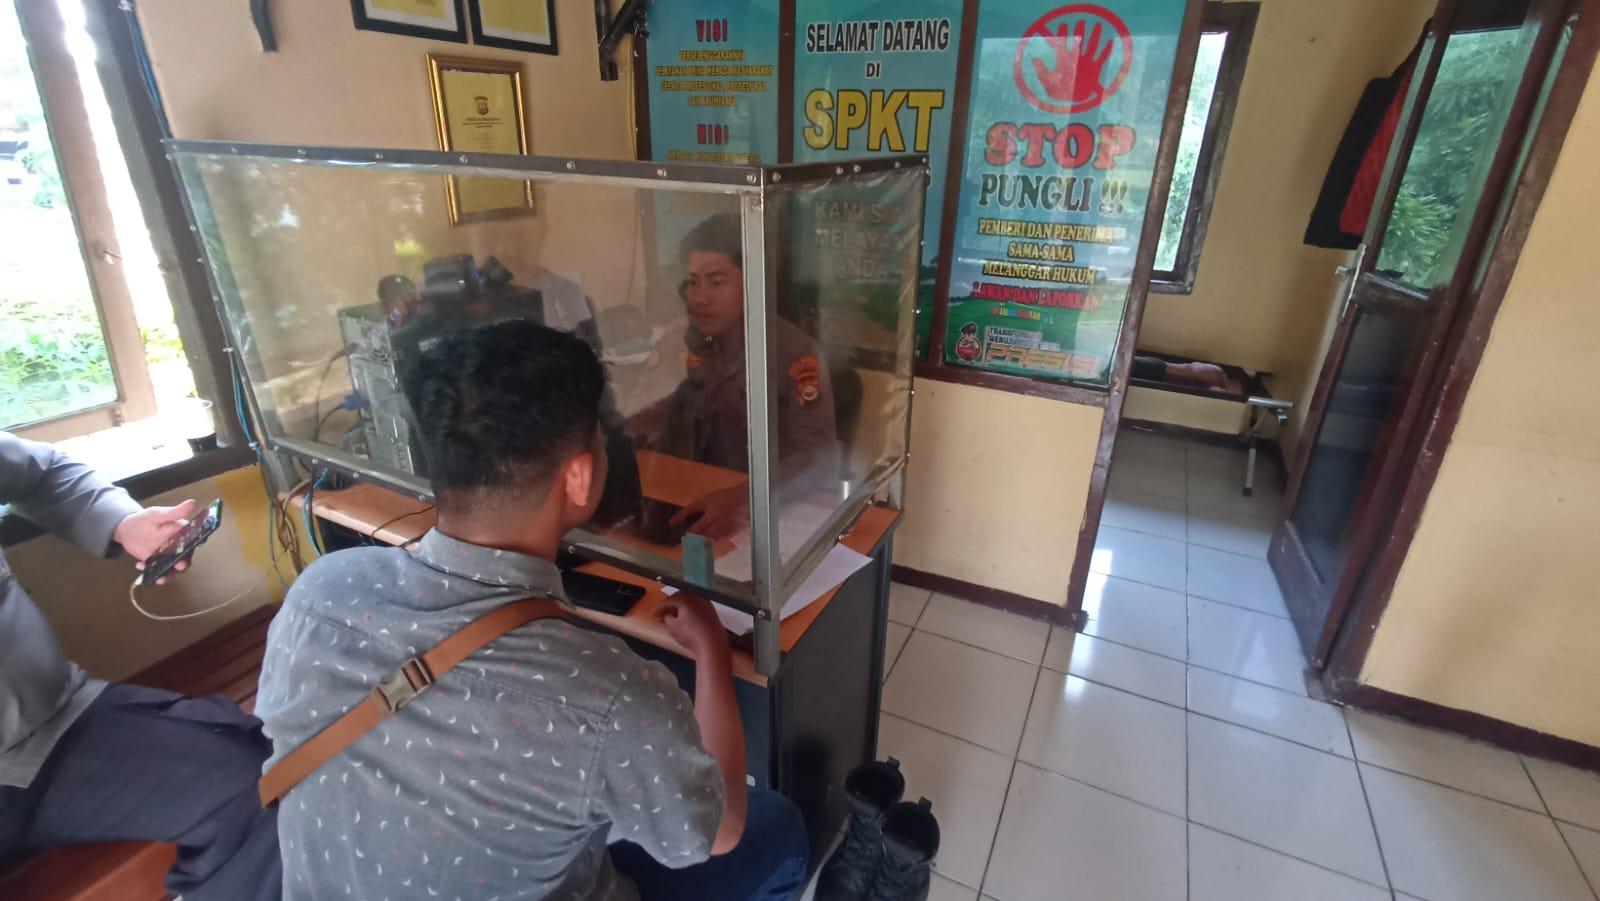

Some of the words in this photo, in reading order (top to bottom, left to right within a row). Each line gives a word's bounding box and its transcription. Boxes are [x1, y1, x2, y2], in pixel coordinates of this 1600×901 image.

[696, 19, 728, 42] VISI
[806, 22, 879, 53] SELAMAT
[883, 19, 950, 52] DATANG
[866, 62, 881, 78] DI
[803, 89, 945, 152] SPKT
[984, 122, 1136, 169] STOP
[979, 173, 1095, 213] PUNGLI
[978, 218, 1026, 237] PEMBERI
[1027, 221, 1051, 239] DAN
[1051, 222, 1116, 244] PENERIMA
[1007, 241, 1075, 262] SAMA-SAMA
[983, 260, 1051, 281] MELANGGAR
[1052, 265, 1097, 285] HUKUM
